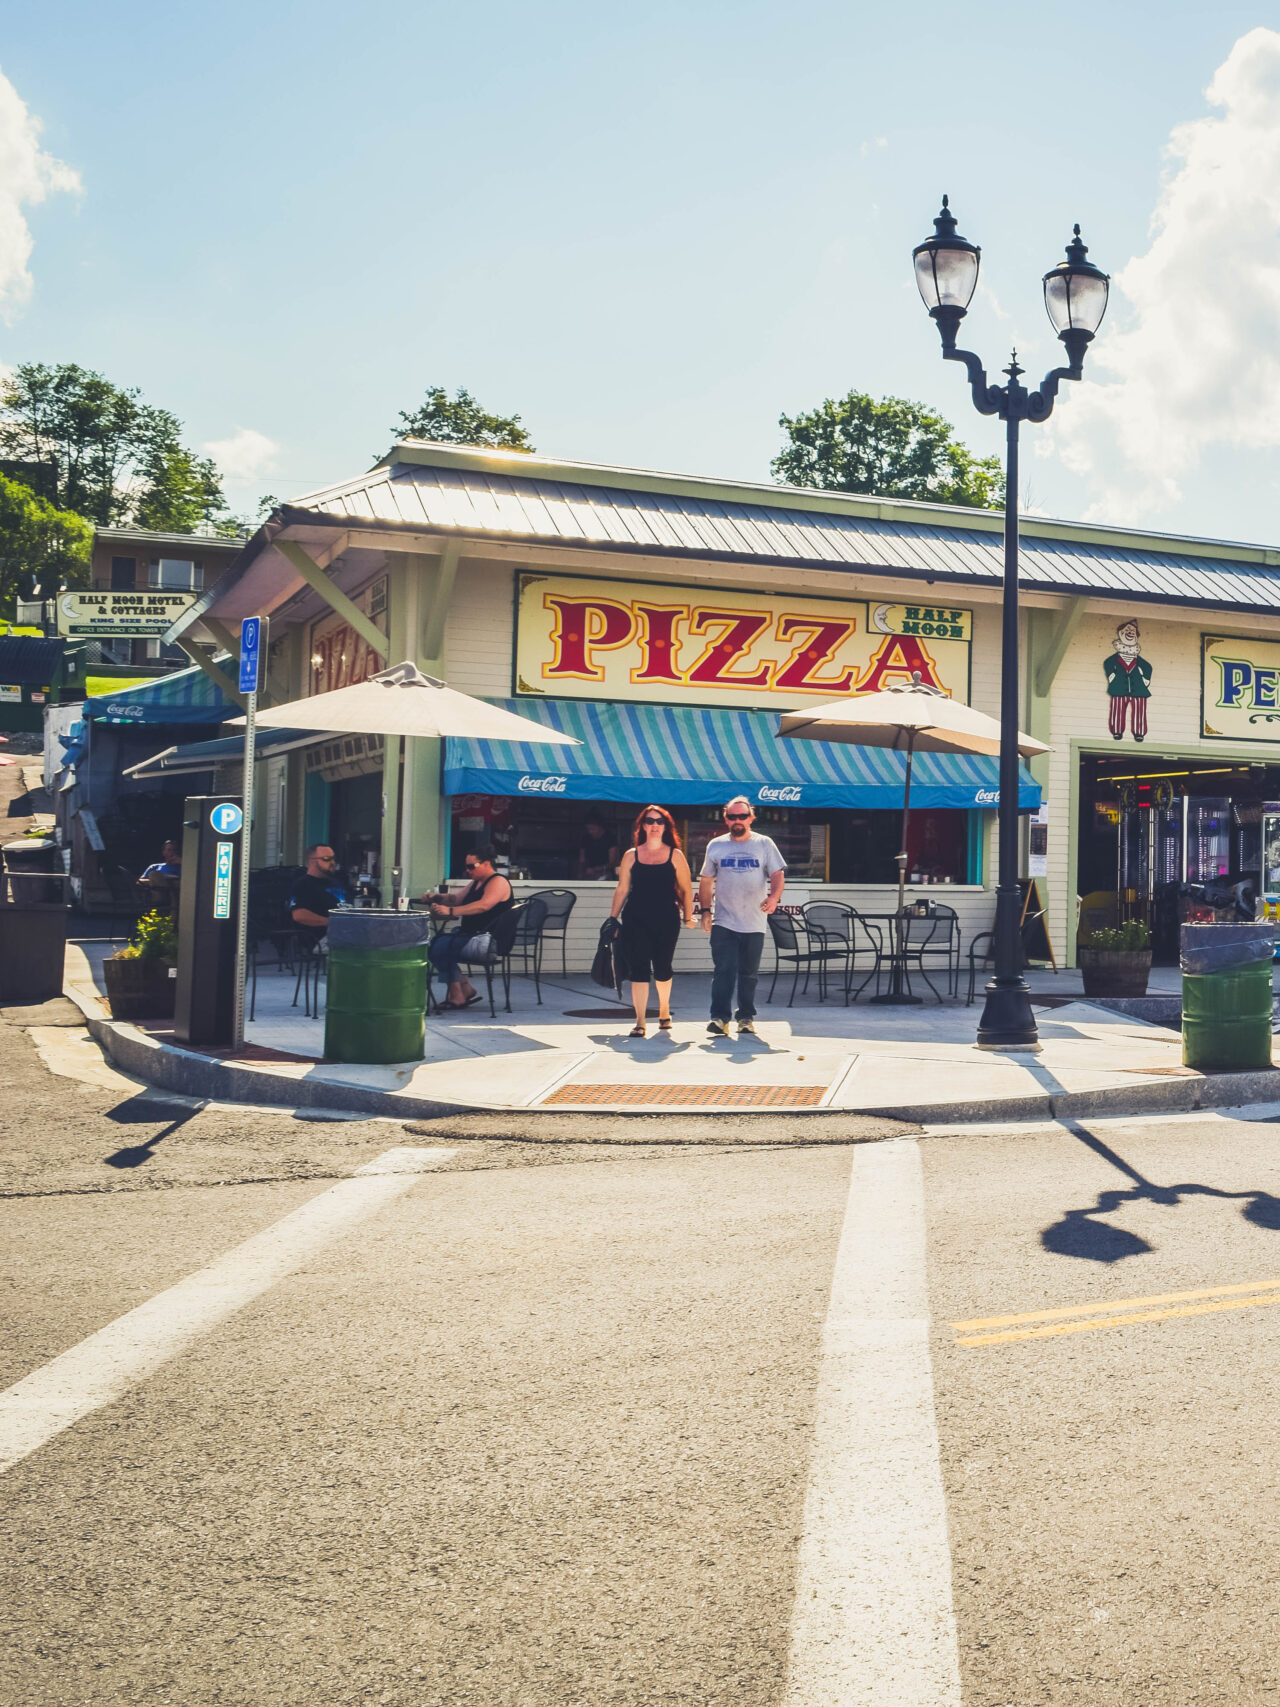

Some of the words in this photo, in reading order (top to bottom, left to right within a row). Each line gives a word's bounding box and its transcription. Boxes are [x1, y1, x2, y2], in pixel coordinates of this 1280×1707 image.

[79, 596, 107, 604] HALF
[112, 596, 144, 605] MOON
[147, 597, 185, 605] MOTEL
[98, 606, 107, 615] &
[111, 607, 166, 615] COTTAGES
[904, 607, 963, 624] HALF
[901, 621, 964, 638] MOON
[542, 593, 952, 698] PIZZA
[518, 775, 568, 793] Coca-Cola
[758, 785, 803, 802] Coca-Cola
[219, 845, 230, 874] PAY
[217, 878, 228, 915] HERE
